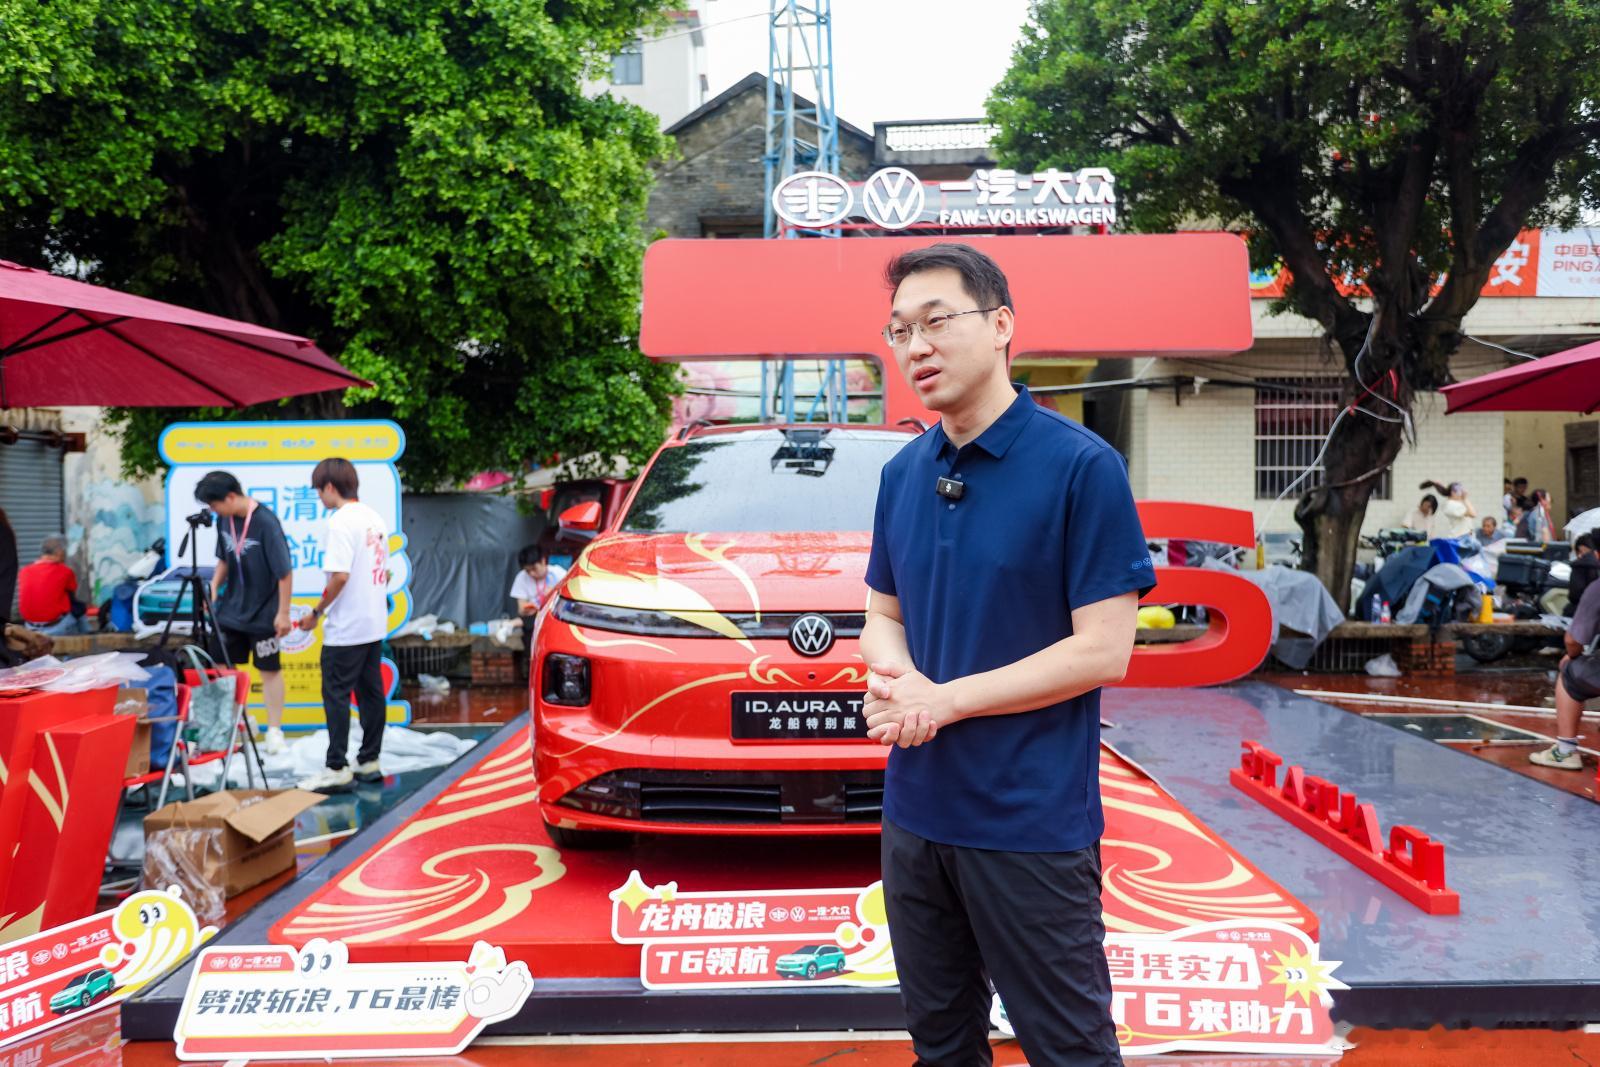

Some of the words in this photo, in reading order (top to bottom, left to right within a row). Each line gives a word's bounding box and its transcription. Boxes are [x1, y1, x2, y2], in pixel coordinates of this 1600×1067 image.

[940, 207, 1116, 226] FAW-VOLKSWAGEN
[745, 700, 773, 713] ID.
[776, 700, 842, 713] AURA
[768, 717, 857, 730] 龙船特别版
[639, 902, 767, 932] 龙舟破浪
[655, 946, 770, 976] T6领航
